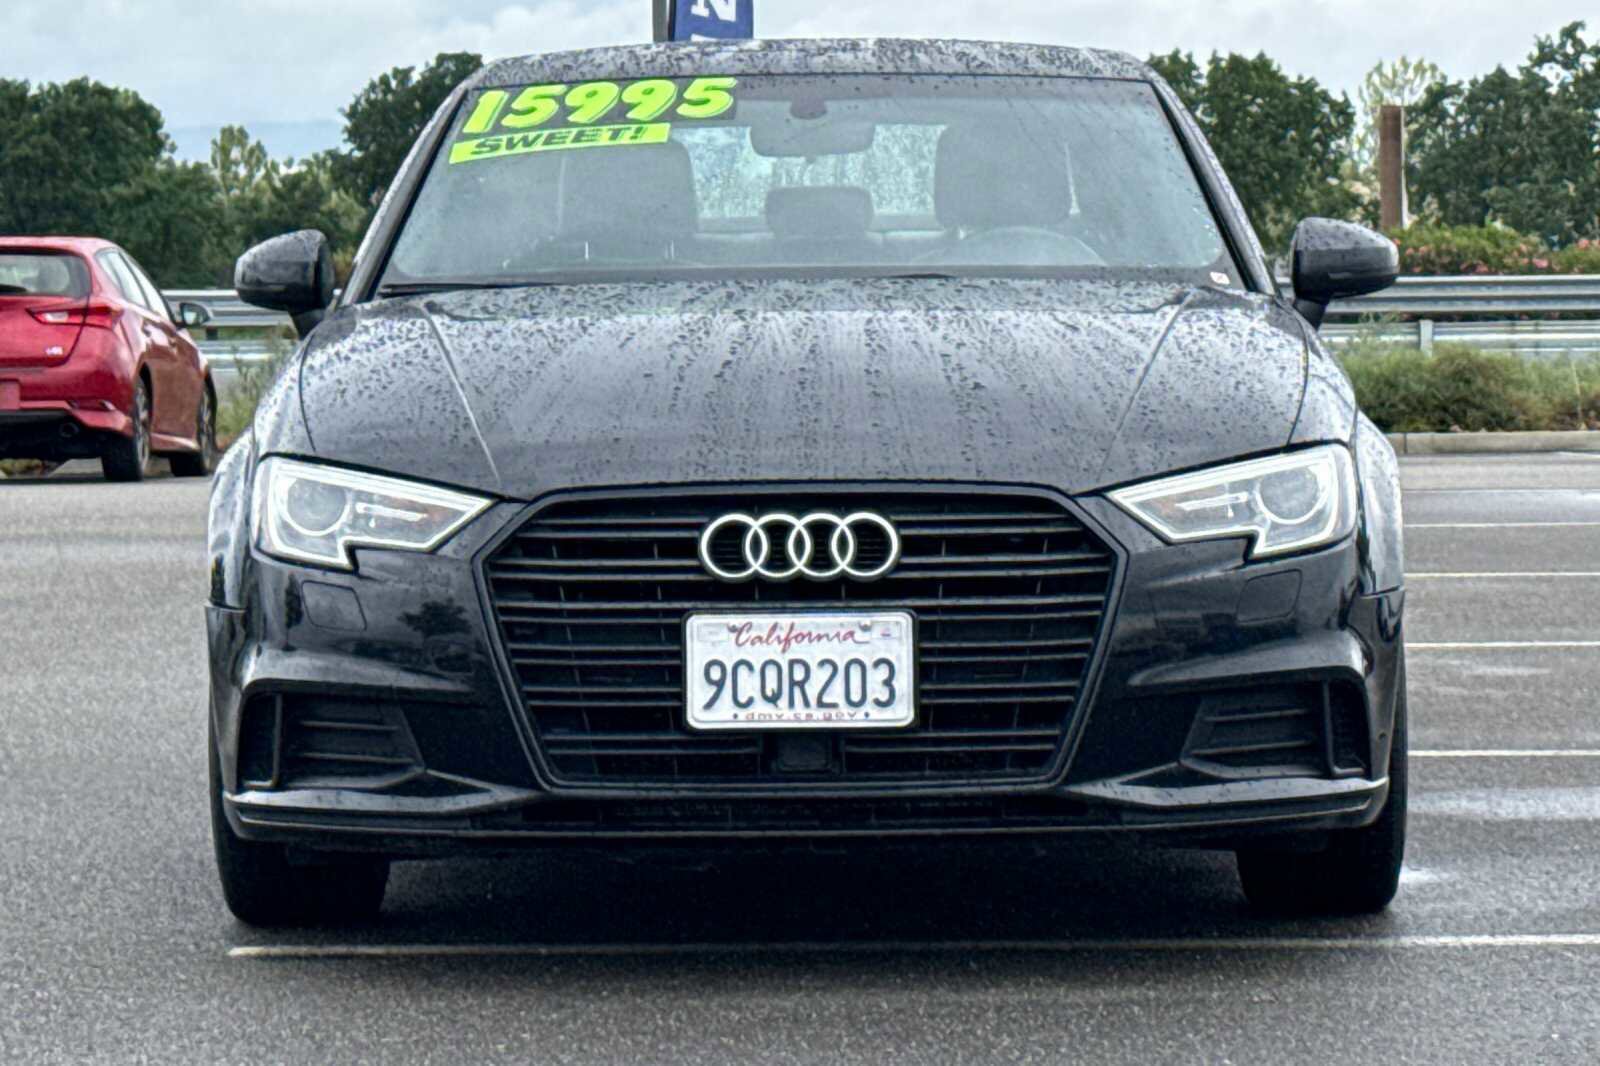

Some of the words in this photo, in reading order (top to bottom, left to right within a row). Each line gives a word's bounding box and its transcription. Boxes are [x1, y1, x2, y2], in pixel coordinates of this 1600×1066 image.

[462, 77, 738, 134] 15995
[470, 125, 644, 155] SWEET!
[734, 621, 869, 653] California
[703, 657, 897, 711] 9CQR203
